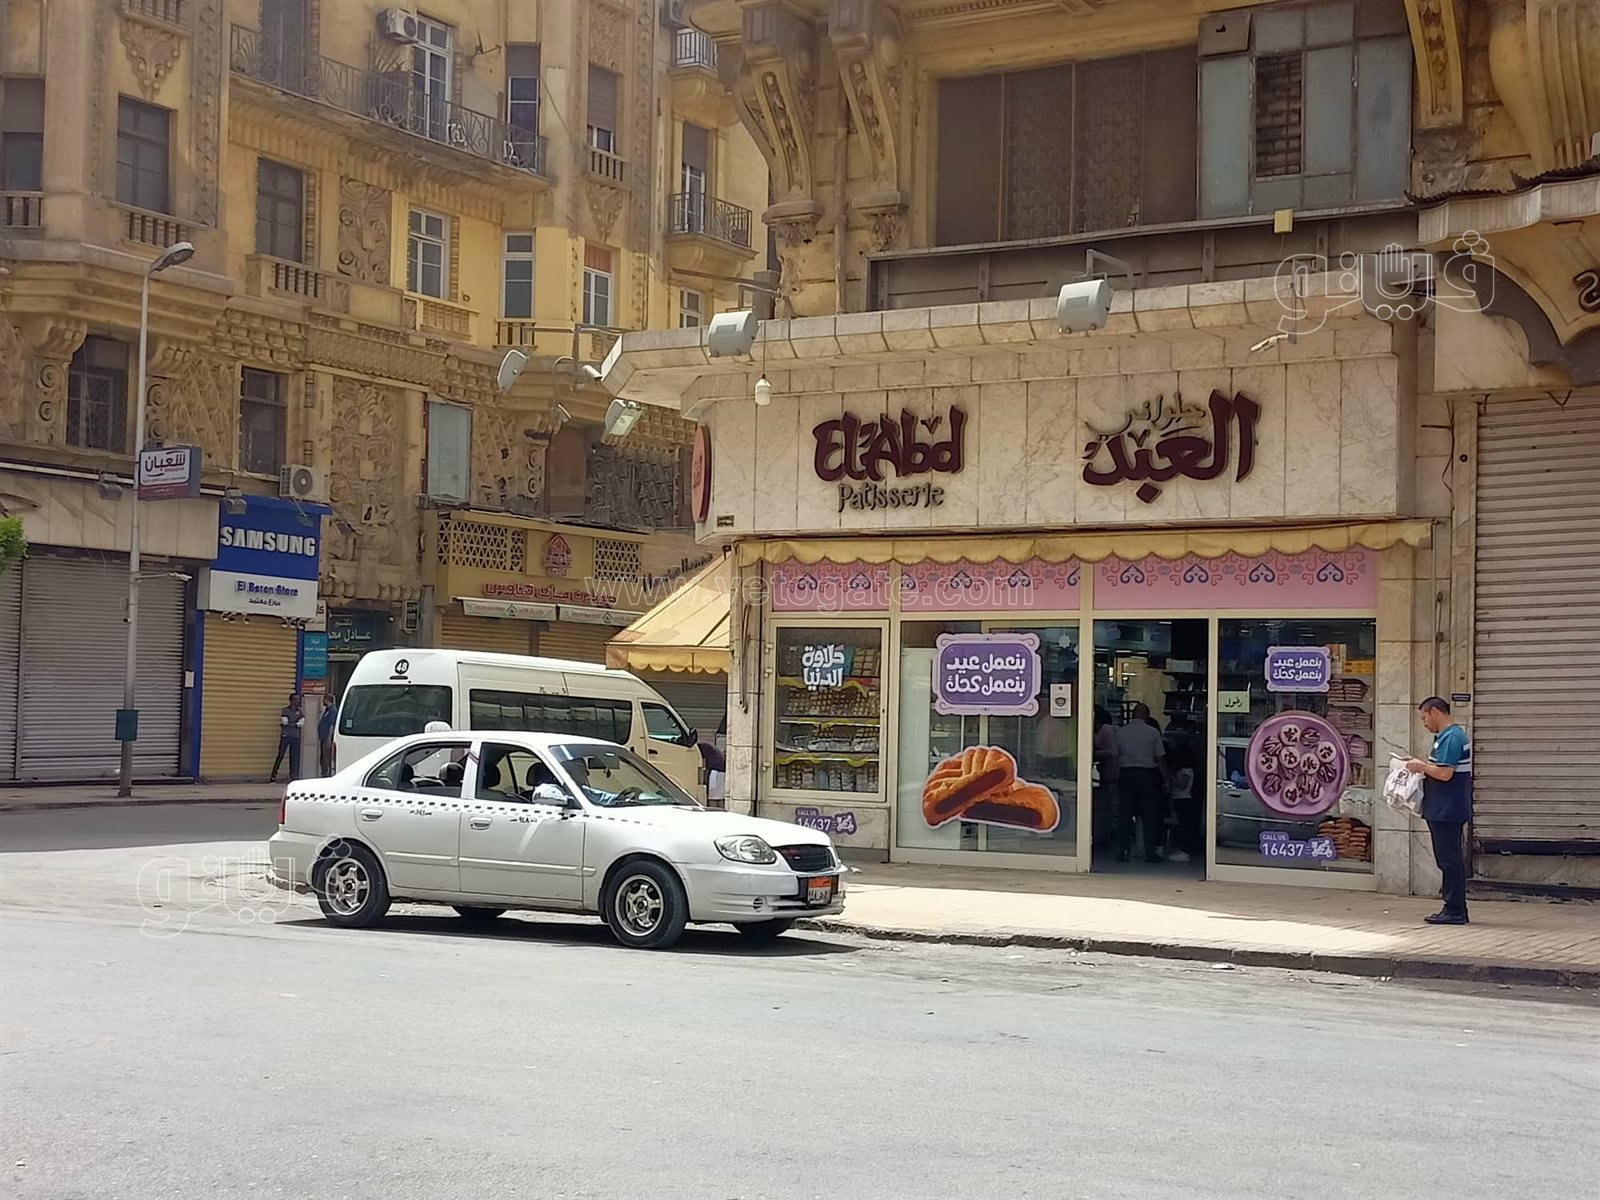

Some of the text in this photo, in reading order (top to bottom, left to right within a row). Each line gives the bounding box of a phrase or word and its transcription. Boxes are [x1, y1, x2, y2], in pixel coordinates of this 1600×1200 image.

[1082, 388, 1261, 504] العبد
[145, 453, 186, 472] شعبان
[838, 482, 945, 513] Patisserie
[220, 526, 316, 557] SAMSUNG
[236, 580, 246, 591] El
[275, 584, 299, 597] Store
[801, 644, 845, 668] حلاوة
[946, 654, 1026, 675] بنعمل عيد
[1273, 657, 1322, 669] بنعمل عيد
[803, 667, 843, 688] الدنيا
[945, 674, 1026, 696] بنعمل كحك
[1273, 669, 1322, 681] بنعمل كحك
[797, 817, 831, 831] 16437
[1262, 833, 1276, 841] CALL
[1263, 842, 1304, 857] 16437
